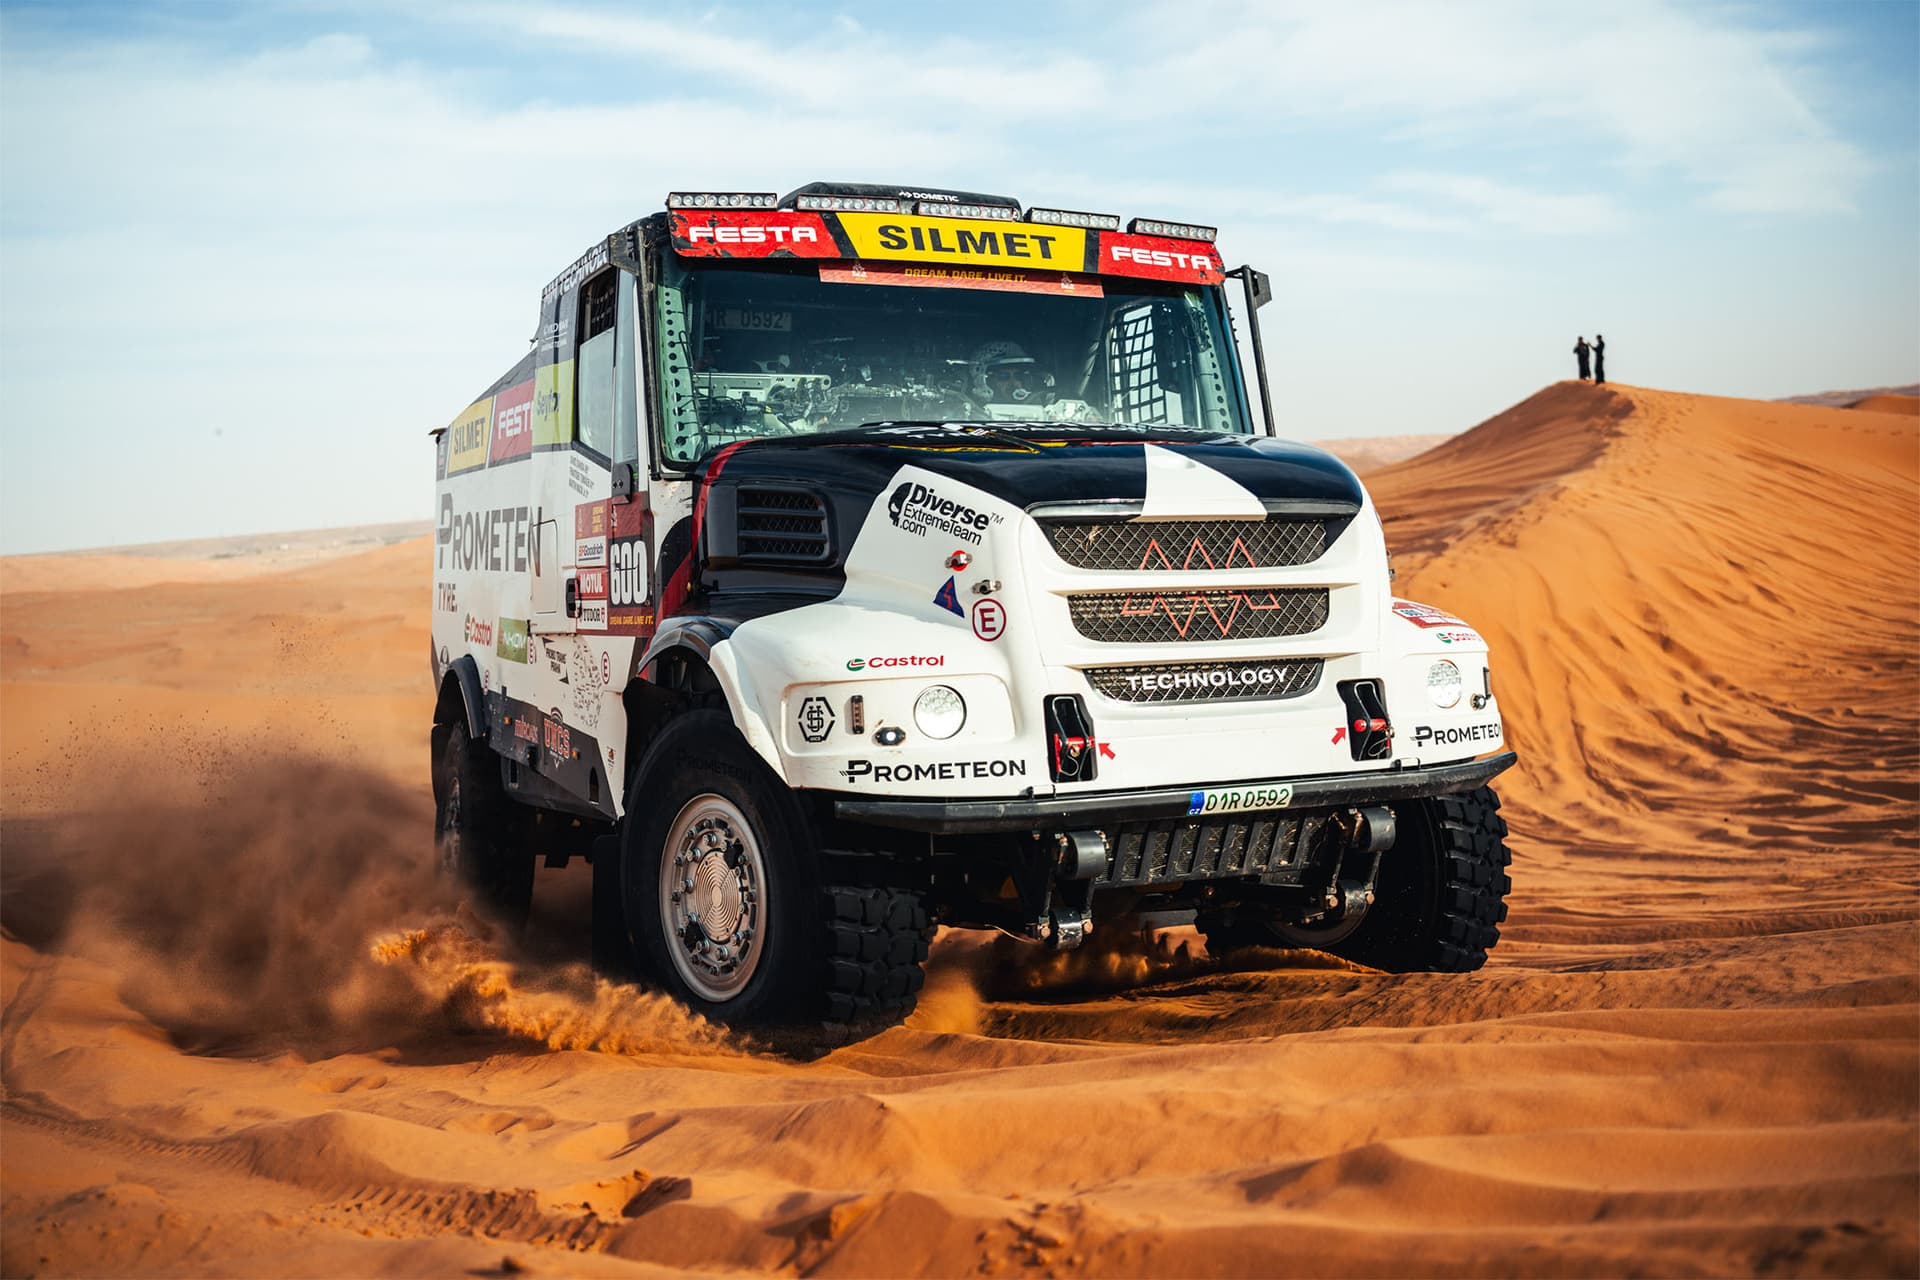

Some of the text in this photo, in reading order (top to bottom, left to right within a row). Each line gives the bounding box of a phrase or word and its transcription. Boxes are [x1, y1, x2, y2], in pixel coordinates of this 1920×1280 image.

[912, 191, 959, 203] DOMETIC
[688, 225, 818, 244] FESTA
[877, 224, 1058, 260] SILMET
[1110, 245, 1214, 271] FESTA
[454, 416, 486, 455] SILMET
[908, 483, 989, 531] Diverse
[899, 518, 927, 537] .com
[903, 503, 982, 546] ExtremeTeam
[610, 540, 648, 606] 600
[868, 655, 944, 670] Castrol
[1125, 667, 1289, 693] TECHNOLOGY
[1415, 723, 1502, 747] PROMETEO
[847, 758, 1026, 784] PROMETEON
[1242, 788, 1290, 808] 0592
